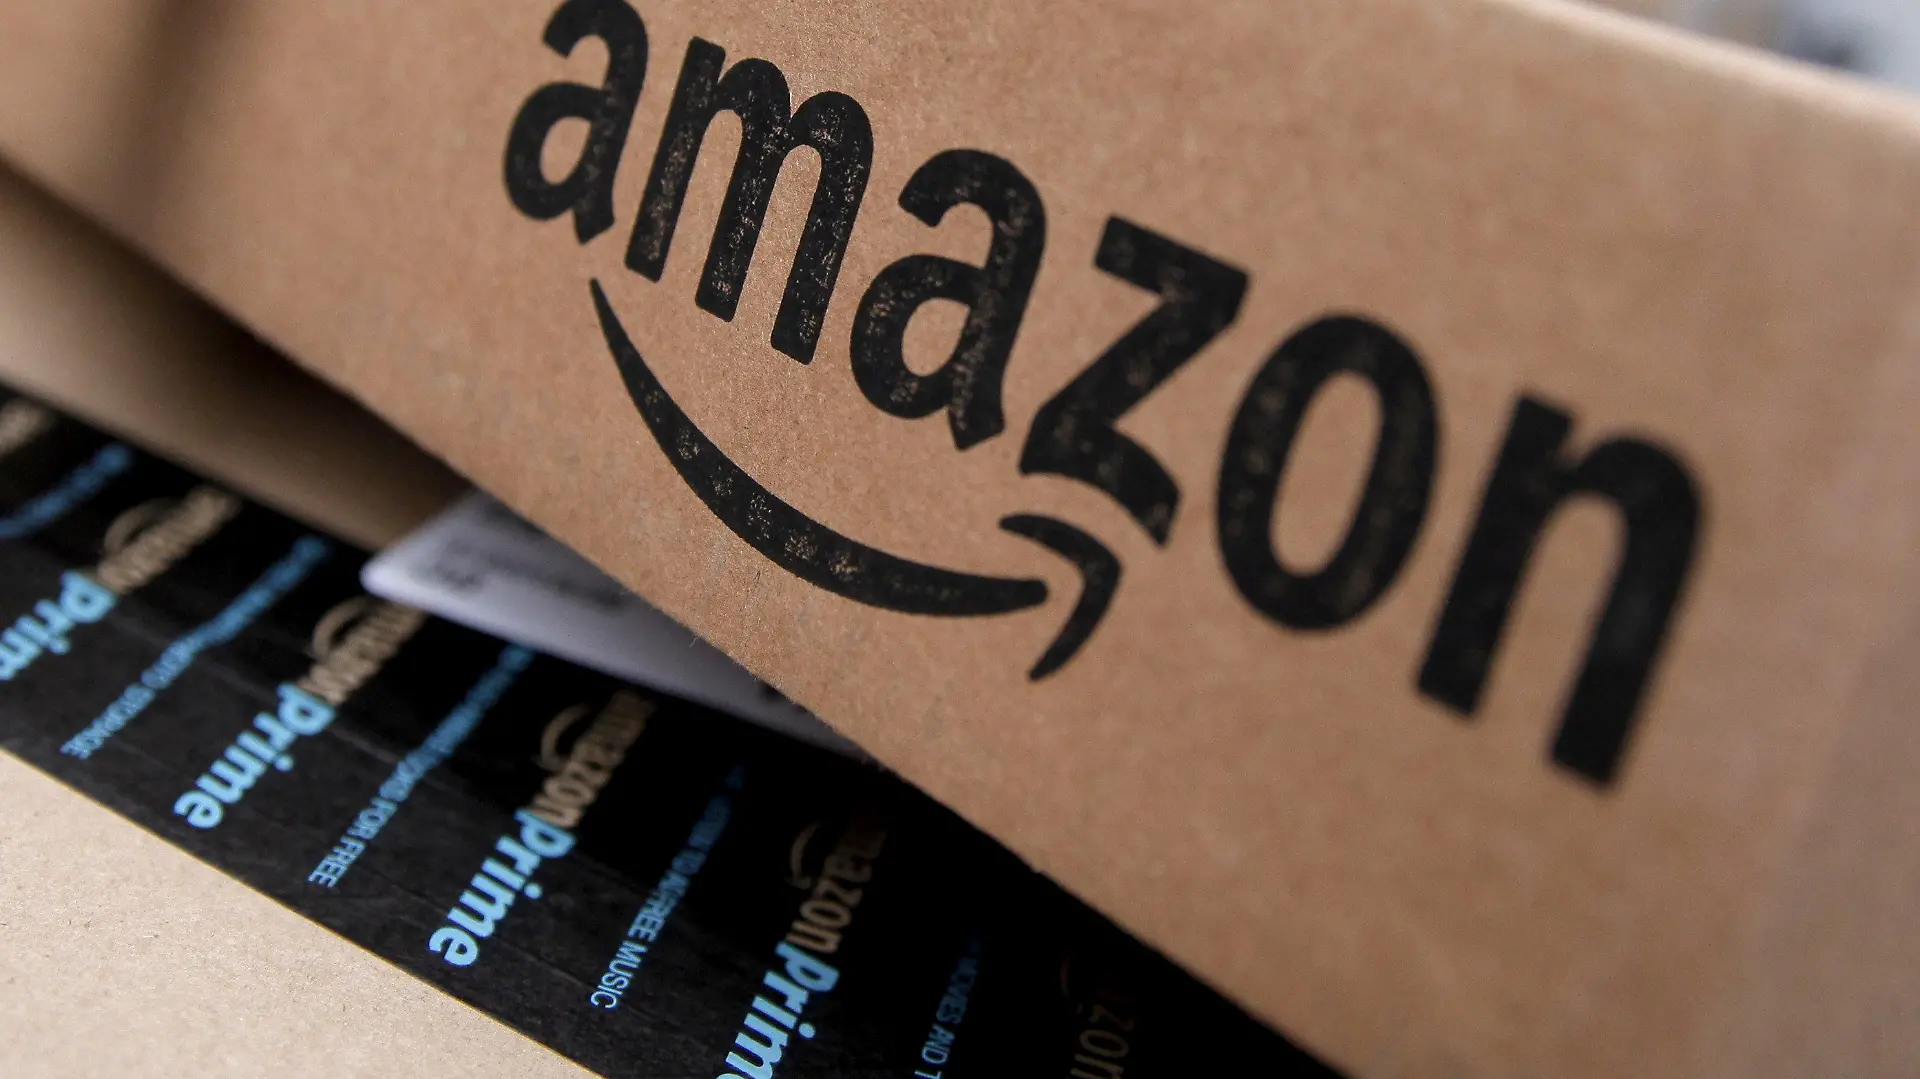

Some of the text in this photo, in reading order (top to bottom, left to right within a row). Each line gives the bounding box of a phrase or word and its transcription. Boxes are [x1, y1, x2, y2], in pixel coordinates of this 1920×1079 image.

[503, 0, 1706, 789] amazon
[173, 682, 336, 829] Prime
[307, 797, 399, 888] FOR FREE
[428, 807, 577, 967] Prime
[590, 939, 650, 1009] MUSIC
[920, 1022, 957, 1065] AND
